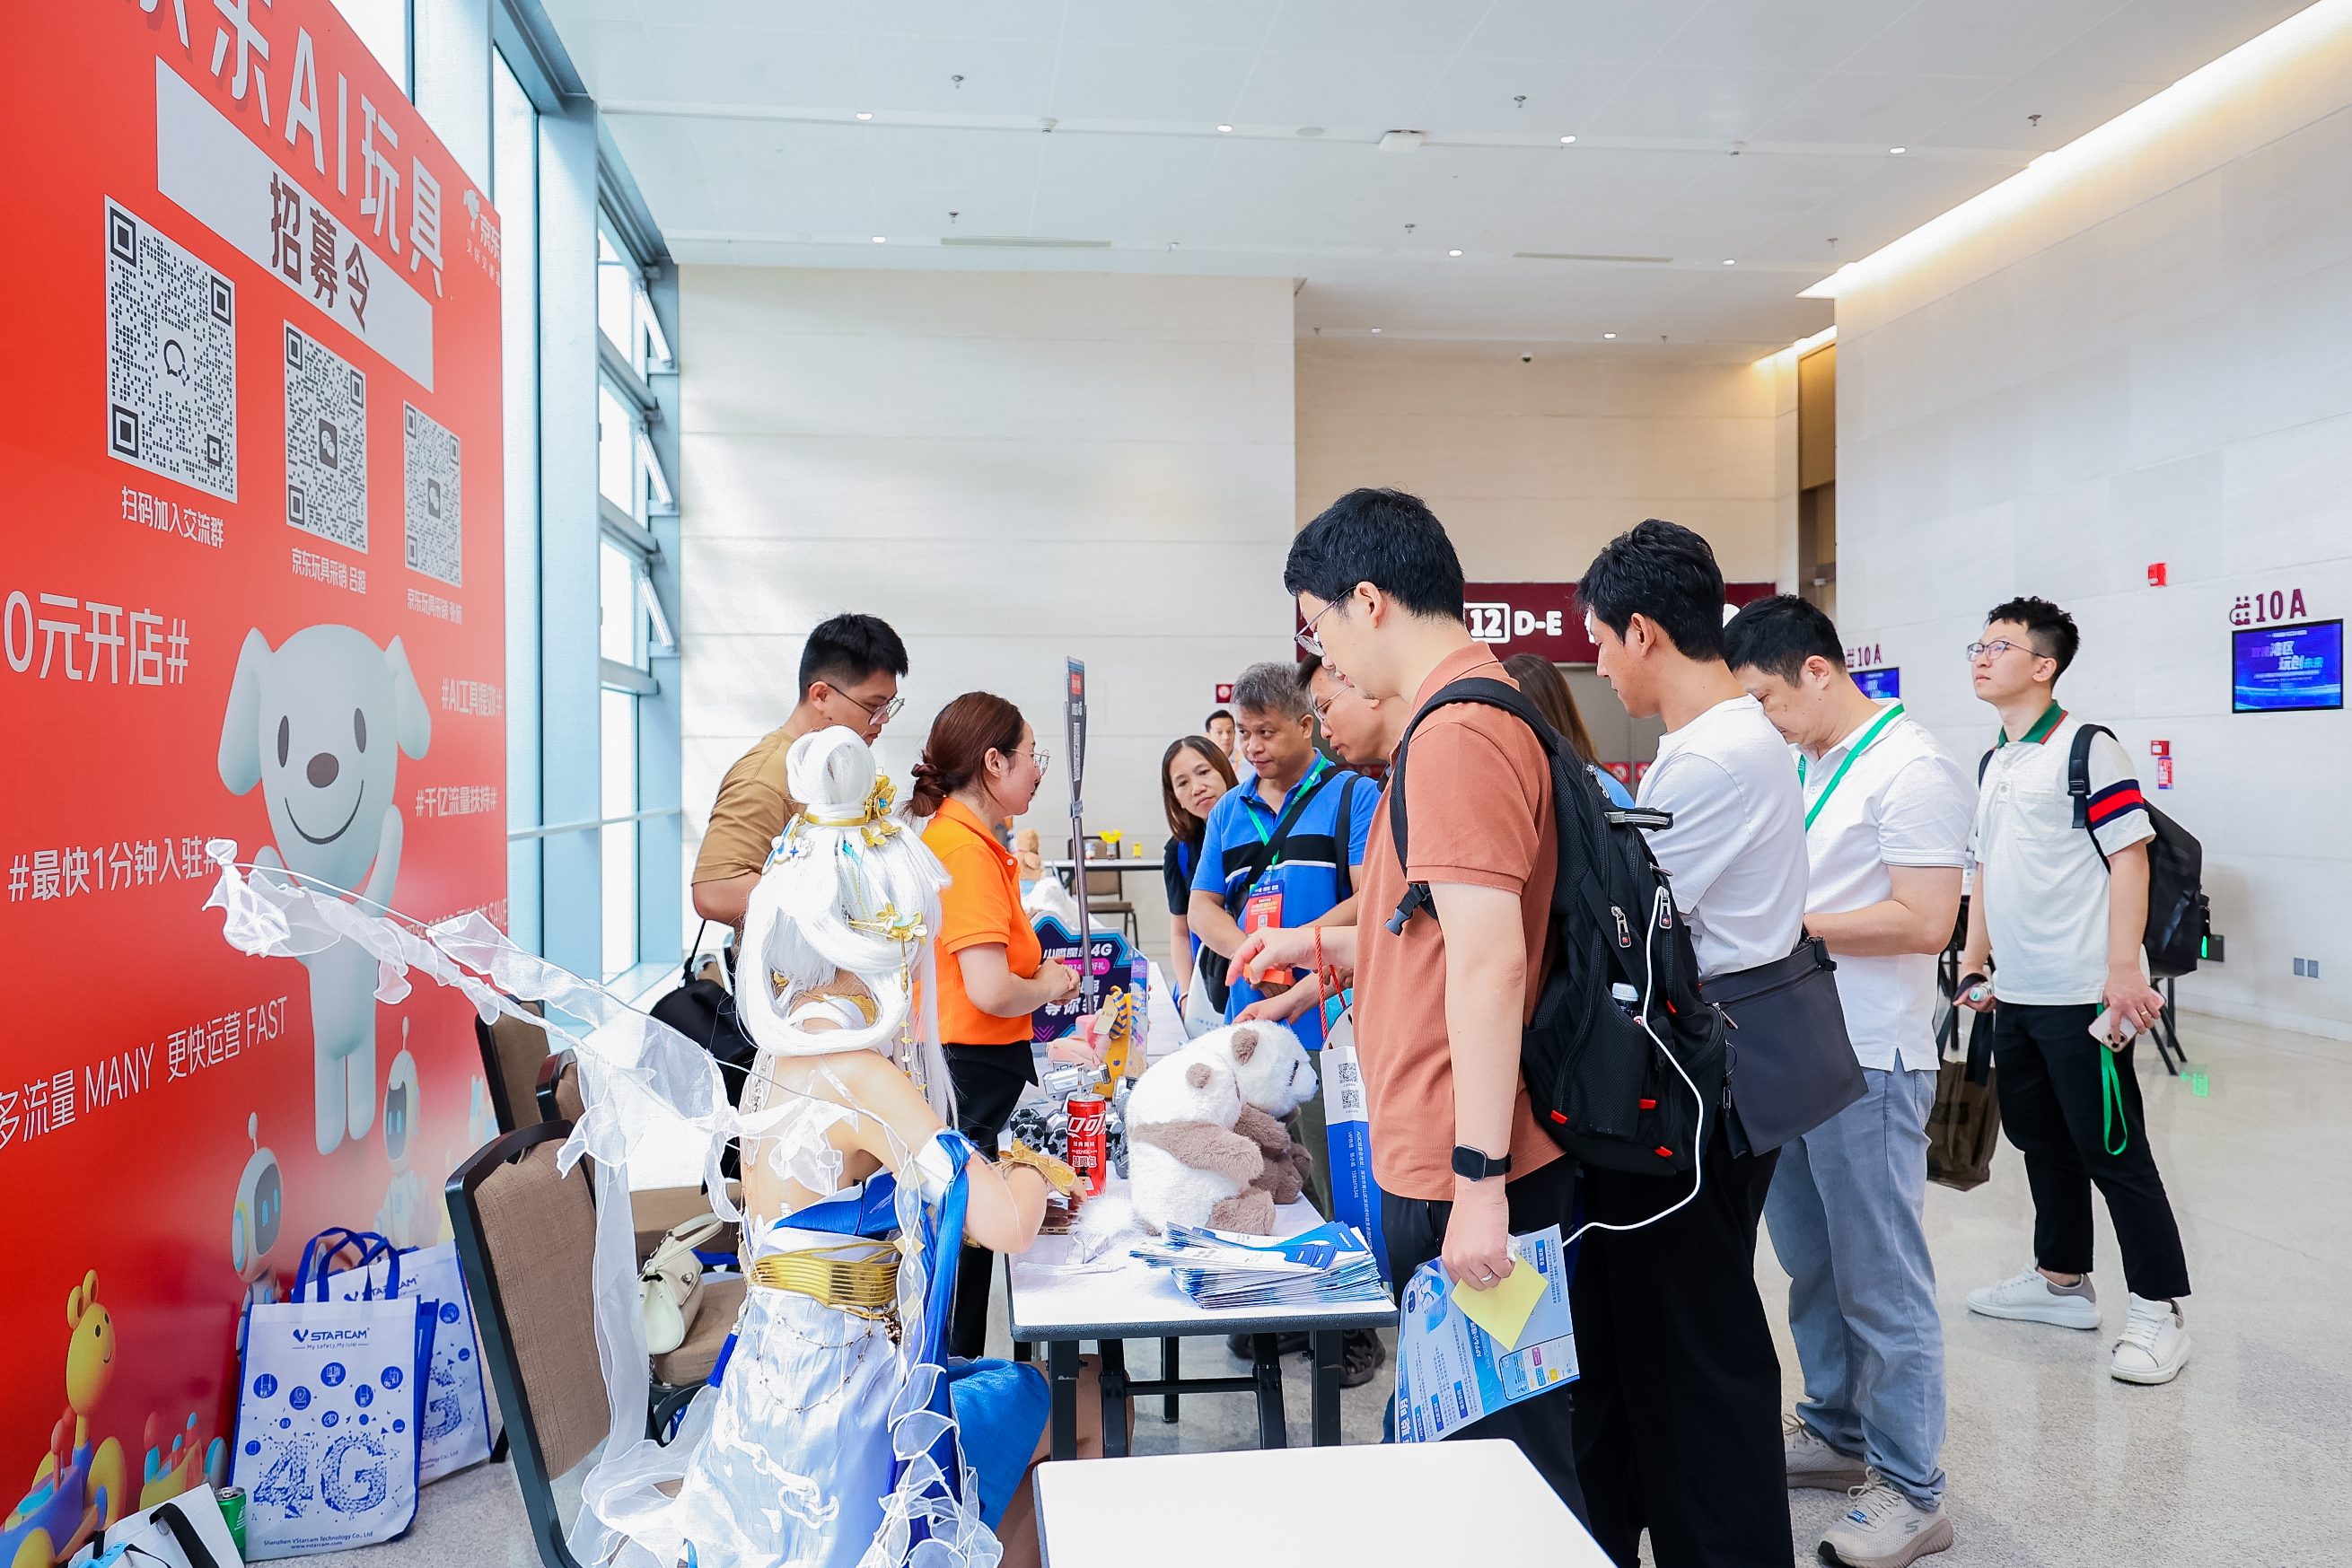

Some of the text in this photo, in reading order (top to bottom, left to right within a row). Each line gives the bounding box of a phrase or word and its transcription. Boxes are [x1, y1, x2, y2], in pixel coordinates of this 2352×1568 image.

[139, 0, 443, 298] 东AI玩具
[270, 171, 370, 333] 招募令
[121, 486, 224, 549] 扫码加入交流群
[292, 547, 366, 594] 京东玩具采销 吕超
[4, 590, 189, 686] 0元开店#
[1470, 609, 1563, 637] 12 D-E
[416, 786, 497, 819] #千亿流量扶持#
[1091, 943, 1112, 957] 4G
[85, 1043, 155, 1114] MANY
[167, 1012, 241, 1083] 更快运营
[246, 996, 287, 1048] FAST
[1073, 1155, 1097, 1168] 显眼包
[252, 1434, 388, 1519] 4G
[263, 1538, 292, 1546] Shenzhen
[292, 1537, 319, 1545] VStarcam
[320, 1534, 352, 1542] Technology
